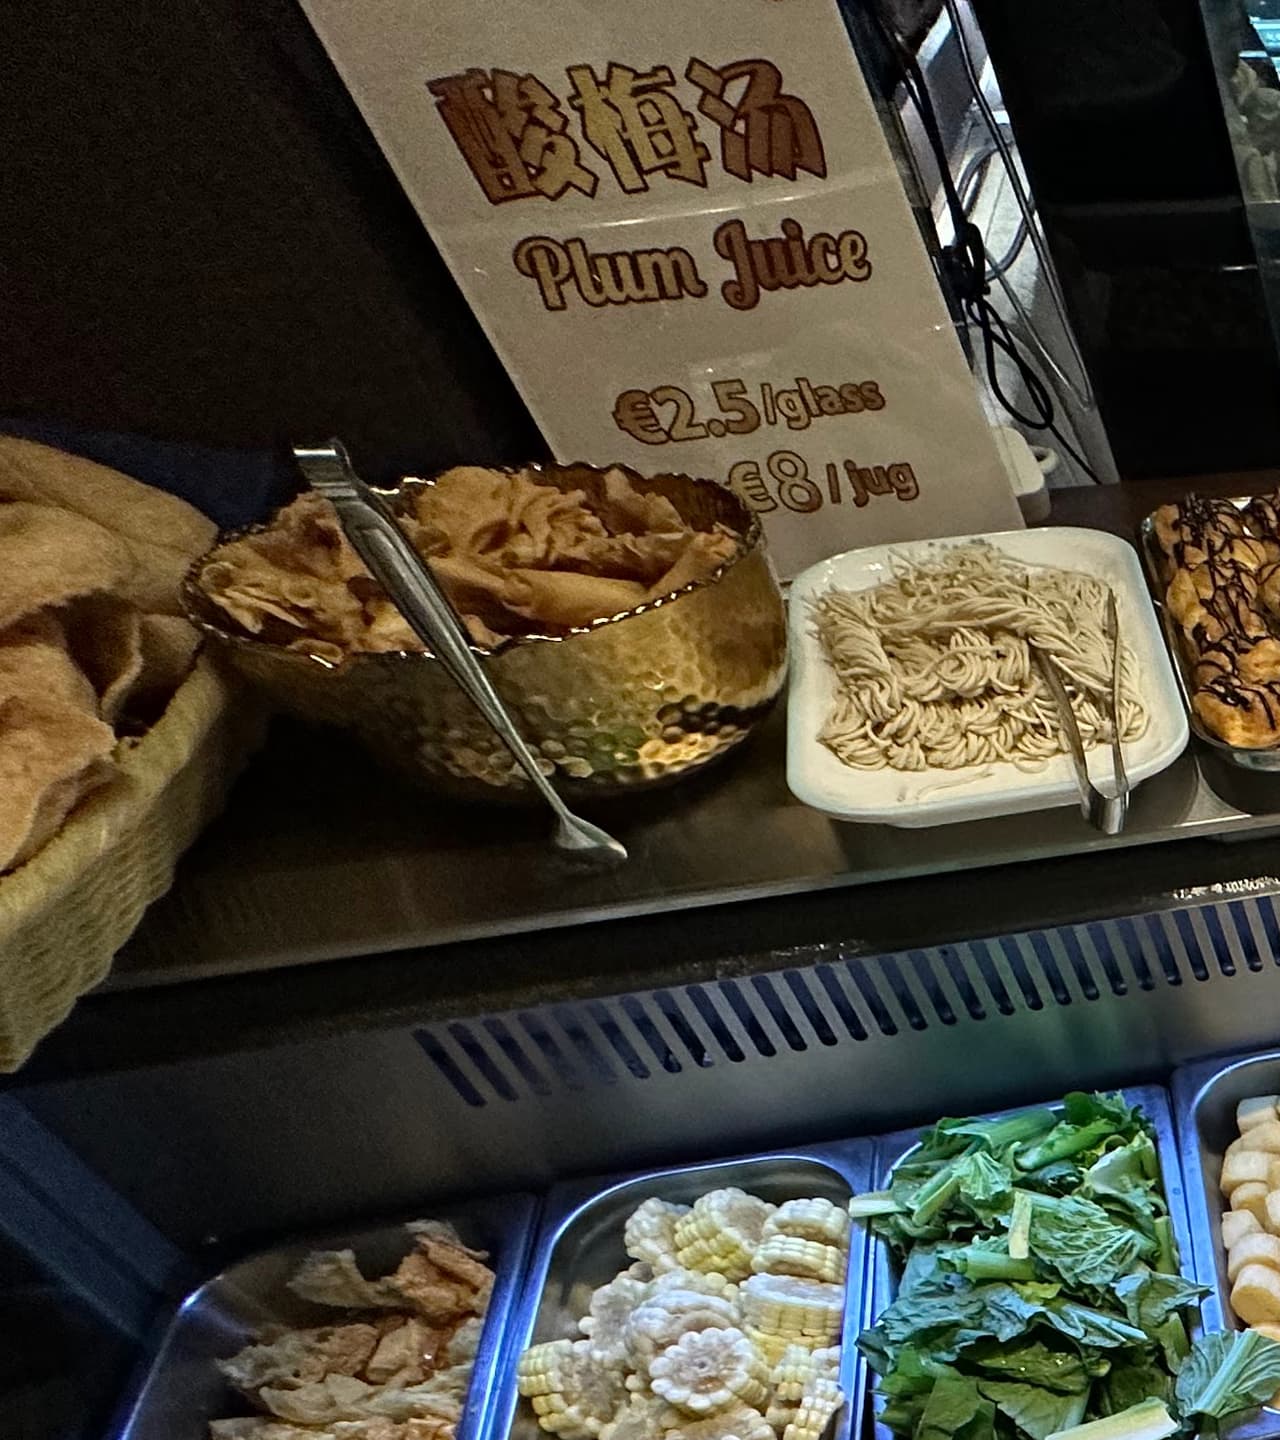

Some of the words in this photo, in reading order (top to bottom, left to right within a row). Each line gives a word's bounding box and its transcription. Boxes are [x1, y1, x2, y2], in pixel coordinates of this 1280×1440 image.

[425, 57, 827, 205] 酸梅汤
[513, 235, 708, 311] Plum
[713, 218, 872, 310] Juice
